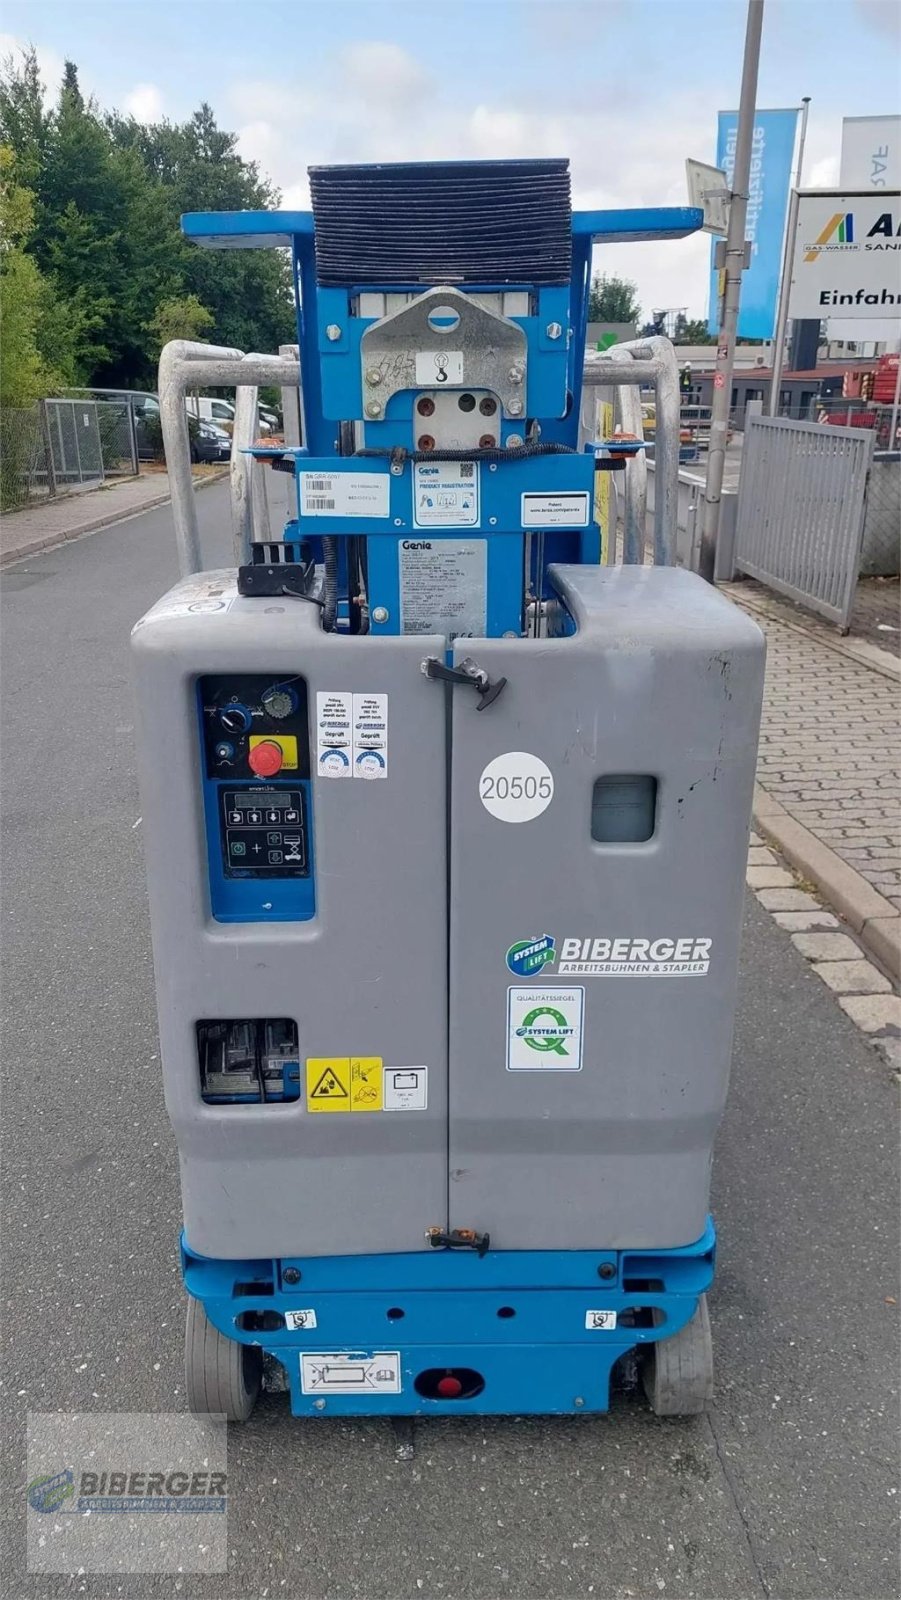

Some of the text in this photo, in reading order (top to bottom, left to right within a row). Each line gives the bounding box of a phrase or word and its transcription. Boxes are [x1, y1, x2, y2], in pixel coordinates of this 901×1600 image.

[402, 540, 432, 550] Genie
[482, 776, 552, 799] 20505
[513, 939, 548, 961] SYSTEM
[560, 938, 712, 961] BIBERGER
[529, 952, 548, 966] LIFT
[562, 963, 705, 973] ARBEITSBÜHNEN & STAPLER
[516, 994, 575, 1003] QUALITÄTSSIEGEL
